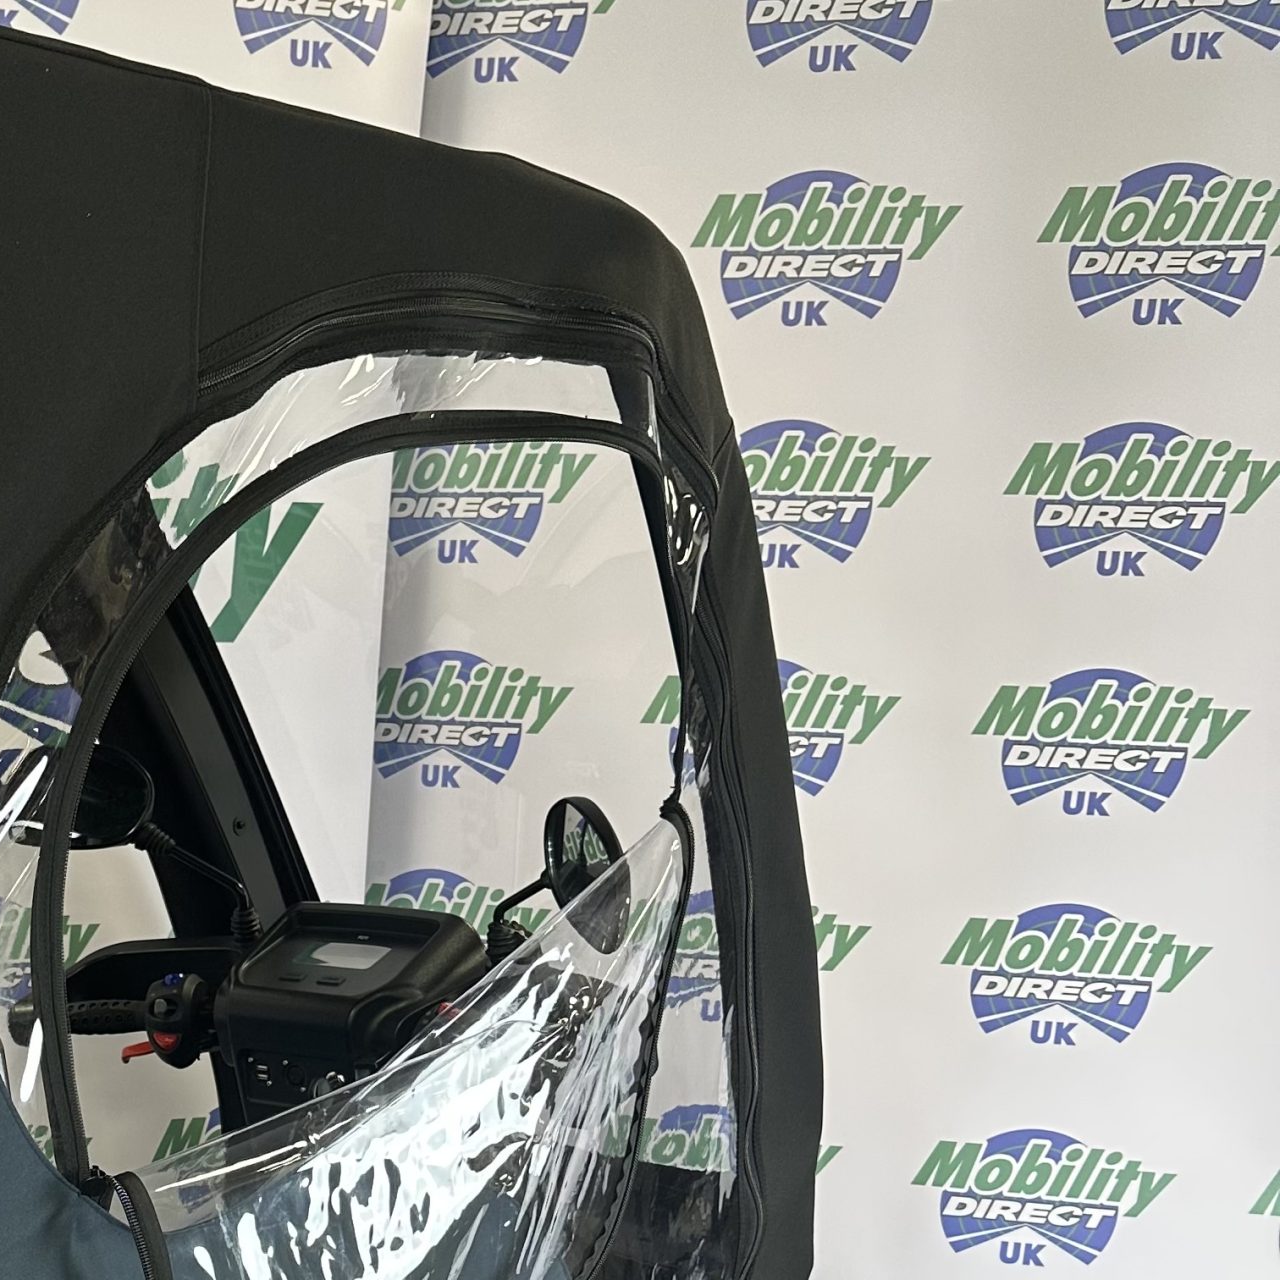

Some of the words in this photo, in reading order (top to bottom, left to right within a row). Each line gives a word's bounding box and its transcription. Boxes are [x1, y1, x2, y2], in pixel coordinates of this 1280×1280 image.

[290, 39, 332, 69] UK
[809, 45, 858, 73] UK
[1171, 32, 1224, 61] UK
[474, 57, 519, 83] UK
[690, 184, 963, 260] Mobility
[1037, 179, 1280, 256] Mobilit
[722, 254, 901, 278] DIRECT
[1071, 250, 1263, 275] DIRECT
[781, 301, 828, 326] UK
[1133, 299, 1185, 325] UK
[741, 435, 932, 508] obility
[1003, 434, 1280, 513] Mobility
[390, 497, 541, 518] DIRECT
[753, 501, 870, 523] RECT
[1037, 505, 1222, 529] DIRECT
[438, 540, 479, 563] UK
[1096, 552, 1146, 577] UK
[783, 675, 901, 744] ility
[972, 682, 1252, 759] Mobility
[375, 723, 519, 747] DIRECT
[1004, 746, 1187, 773] DIRECT
[421, 764, 462, 788] UK
[1062, 791, 1110, 816] UK
[941, 915, 1214, 993] Mobility
[973, 977, 1152, 1005] DIRECT
[1031, 1020, 1077, 1046] UK
[911, 1140, 1177, 1218] Mobility
[942, 1196, 1116, 1229] DIRECT
[999, 1241, 1045, 1267] UK
